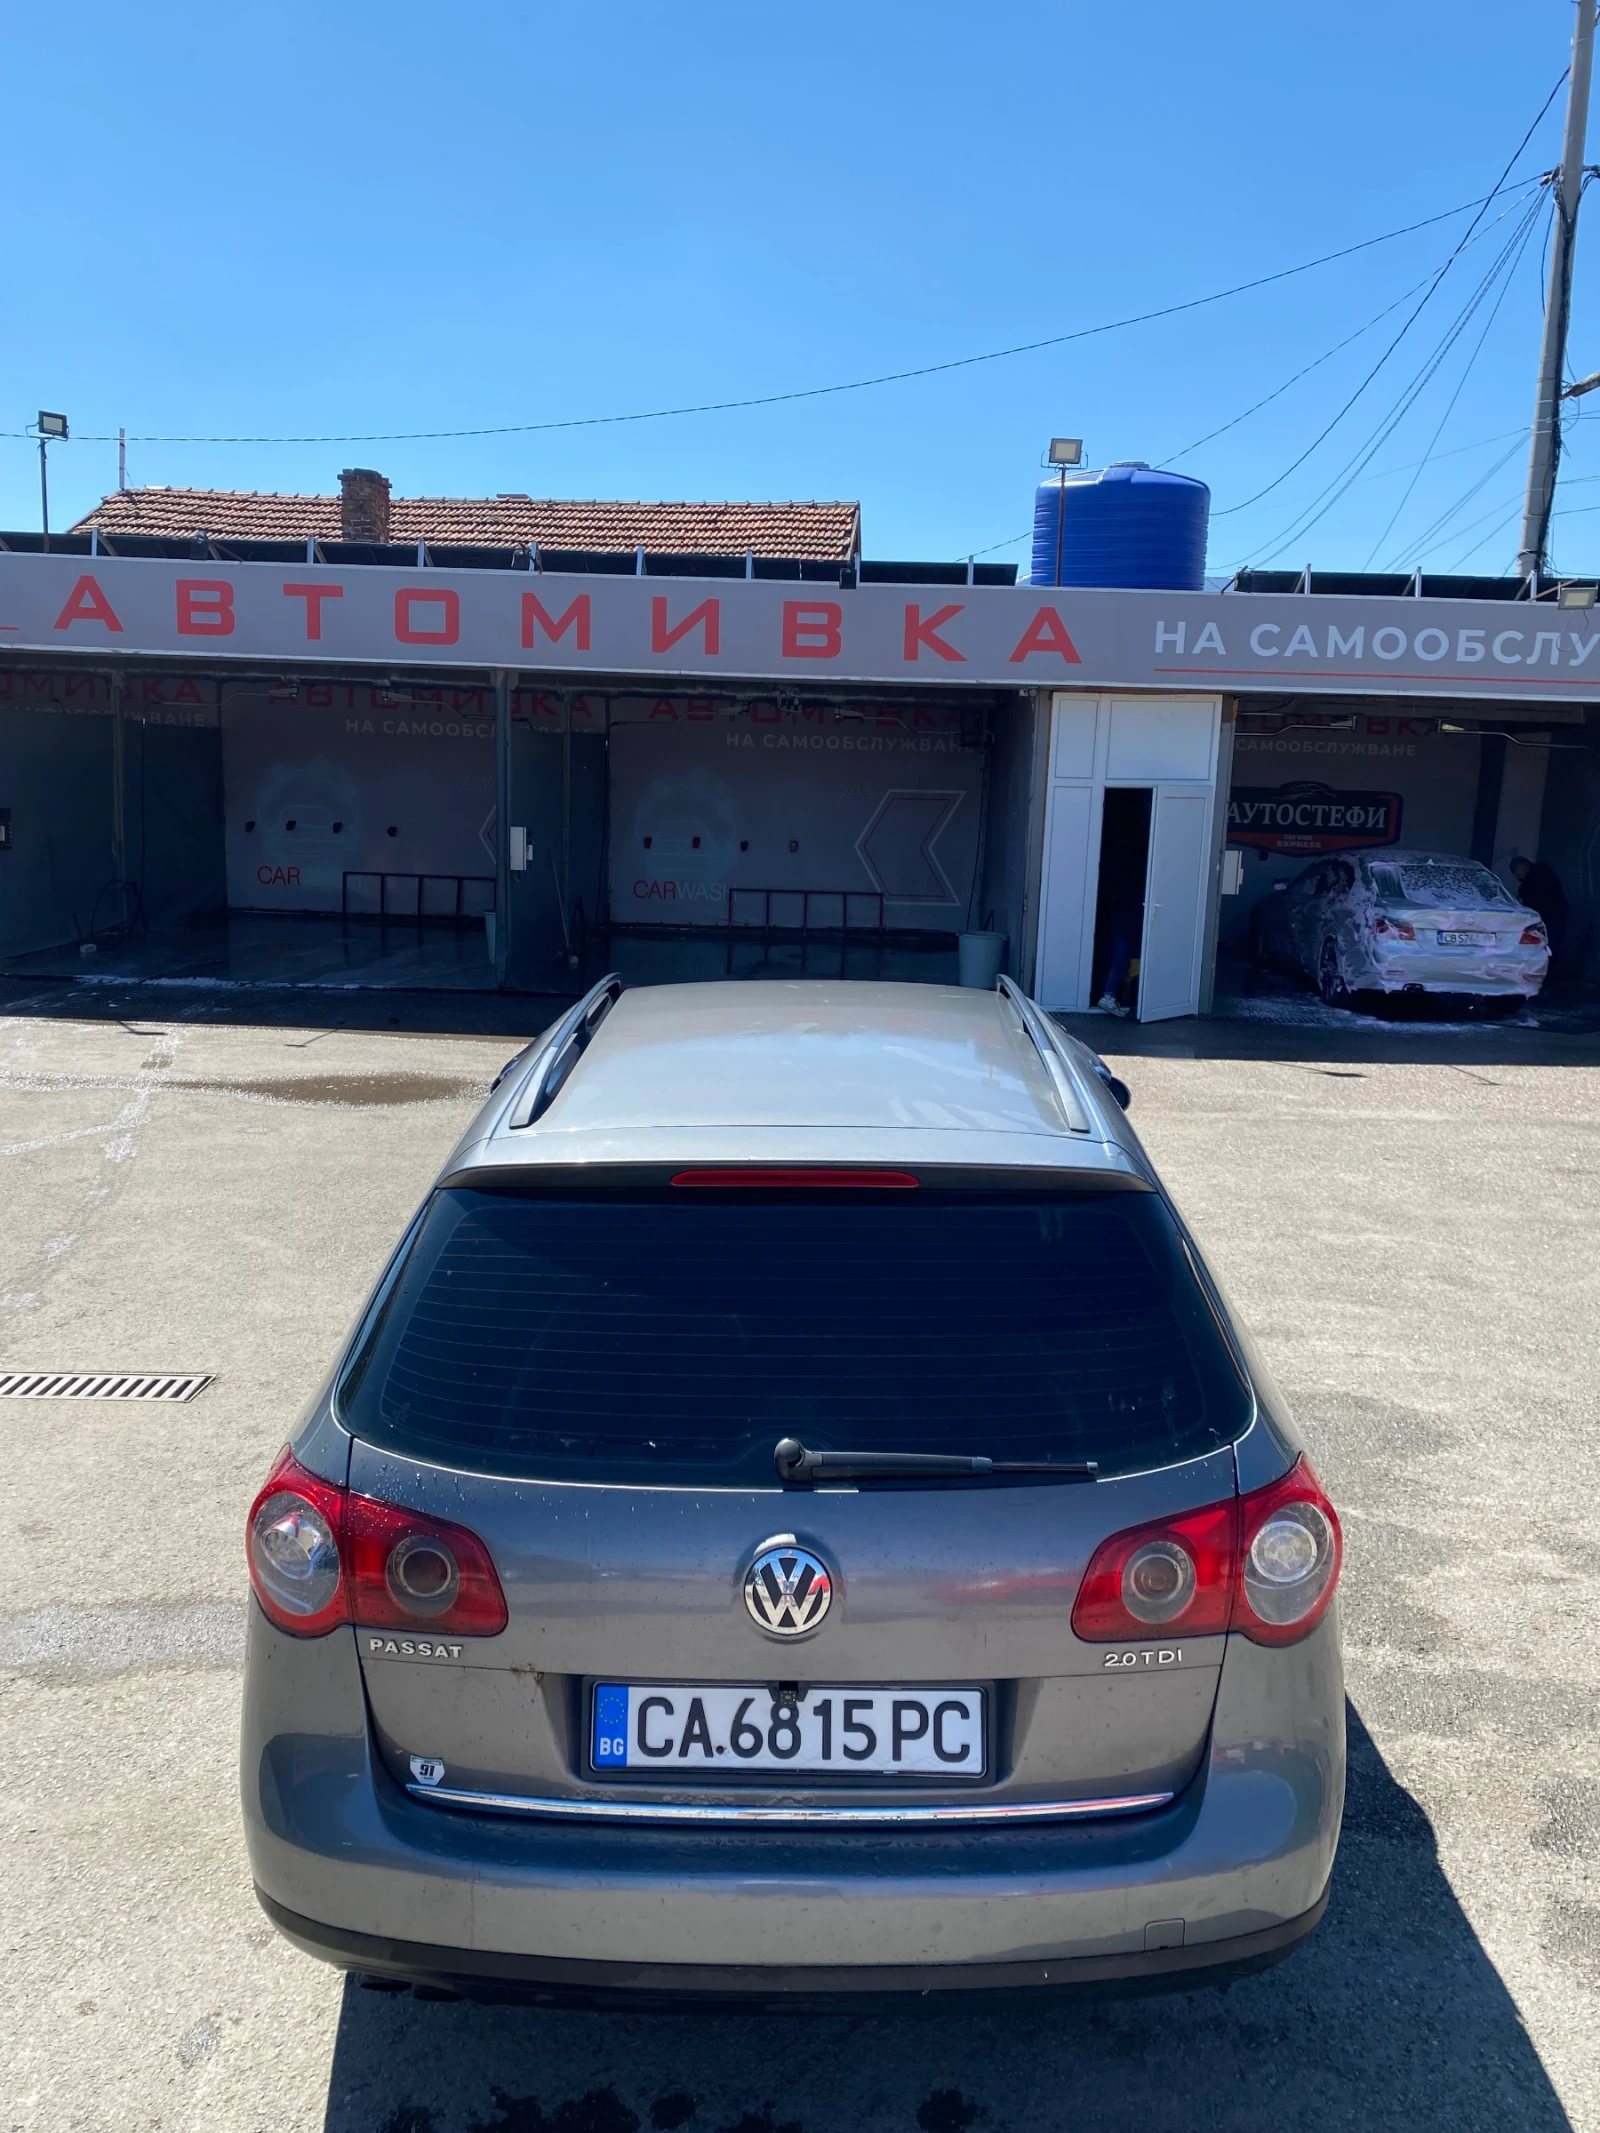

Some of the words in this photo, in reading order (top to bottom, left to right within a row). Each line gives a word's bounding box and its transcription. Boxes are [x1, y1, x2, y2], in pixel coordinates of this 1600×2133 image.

[54, 575, 1082, 664] АВТОМИВКА
[1154, 621, 1226, 655] НА
[346, 719, 374, 734] НА
[726, 732, 755, 748] НА
[1236, 738, 1417, 757] САМООБСЛУЖВАНЕ
[1228, 801, 1388, 829] АУТОСТЕФИ
[1276, 840, 1322, 849] EXPRESS
[257, 866, 301, 886] CAR
[369, 1637, 463, 1659] PASSAT
[600, 1738, 624, 1756] BG
